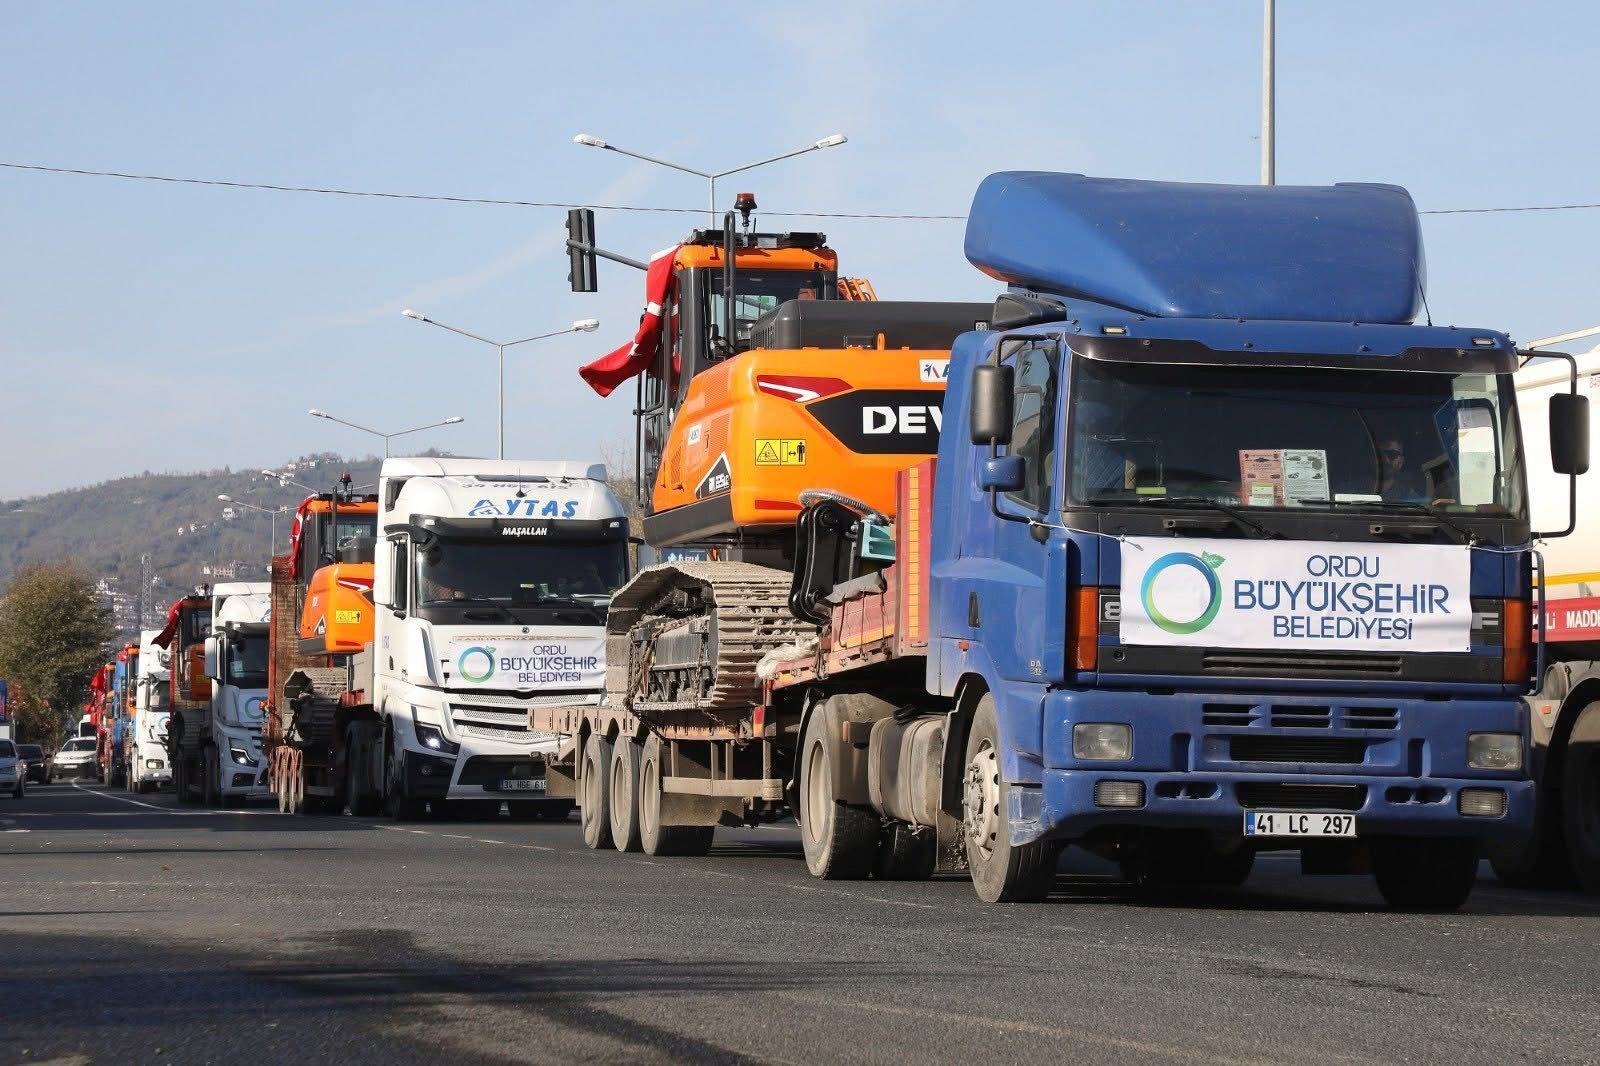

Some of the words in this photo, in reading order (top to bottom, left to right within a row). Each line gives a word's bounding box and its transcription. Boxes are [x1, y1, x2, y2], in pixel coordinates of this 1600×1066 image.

[468, 499, 578, 519] AYTAŞ
[502, 527, 548, 538] MAŞALLAH
[1306, 554, 1380, 578] ORDU
[1234, 579, 1451, 615] BÜYÜKŞEHİR
[1273, 615, 1413, 640] BELEDİYESİ
[532, 645, 567, 656] ORDU
[500, 656, 598, 671] BÜYÜKŞEHİR
[518, 672, 582, 683] BELEDİYESİ
[1257, 815, 1273, 833] 41
[1288, 815, 1309, 834] LC
[1322, 816, 1353, 834] 297
